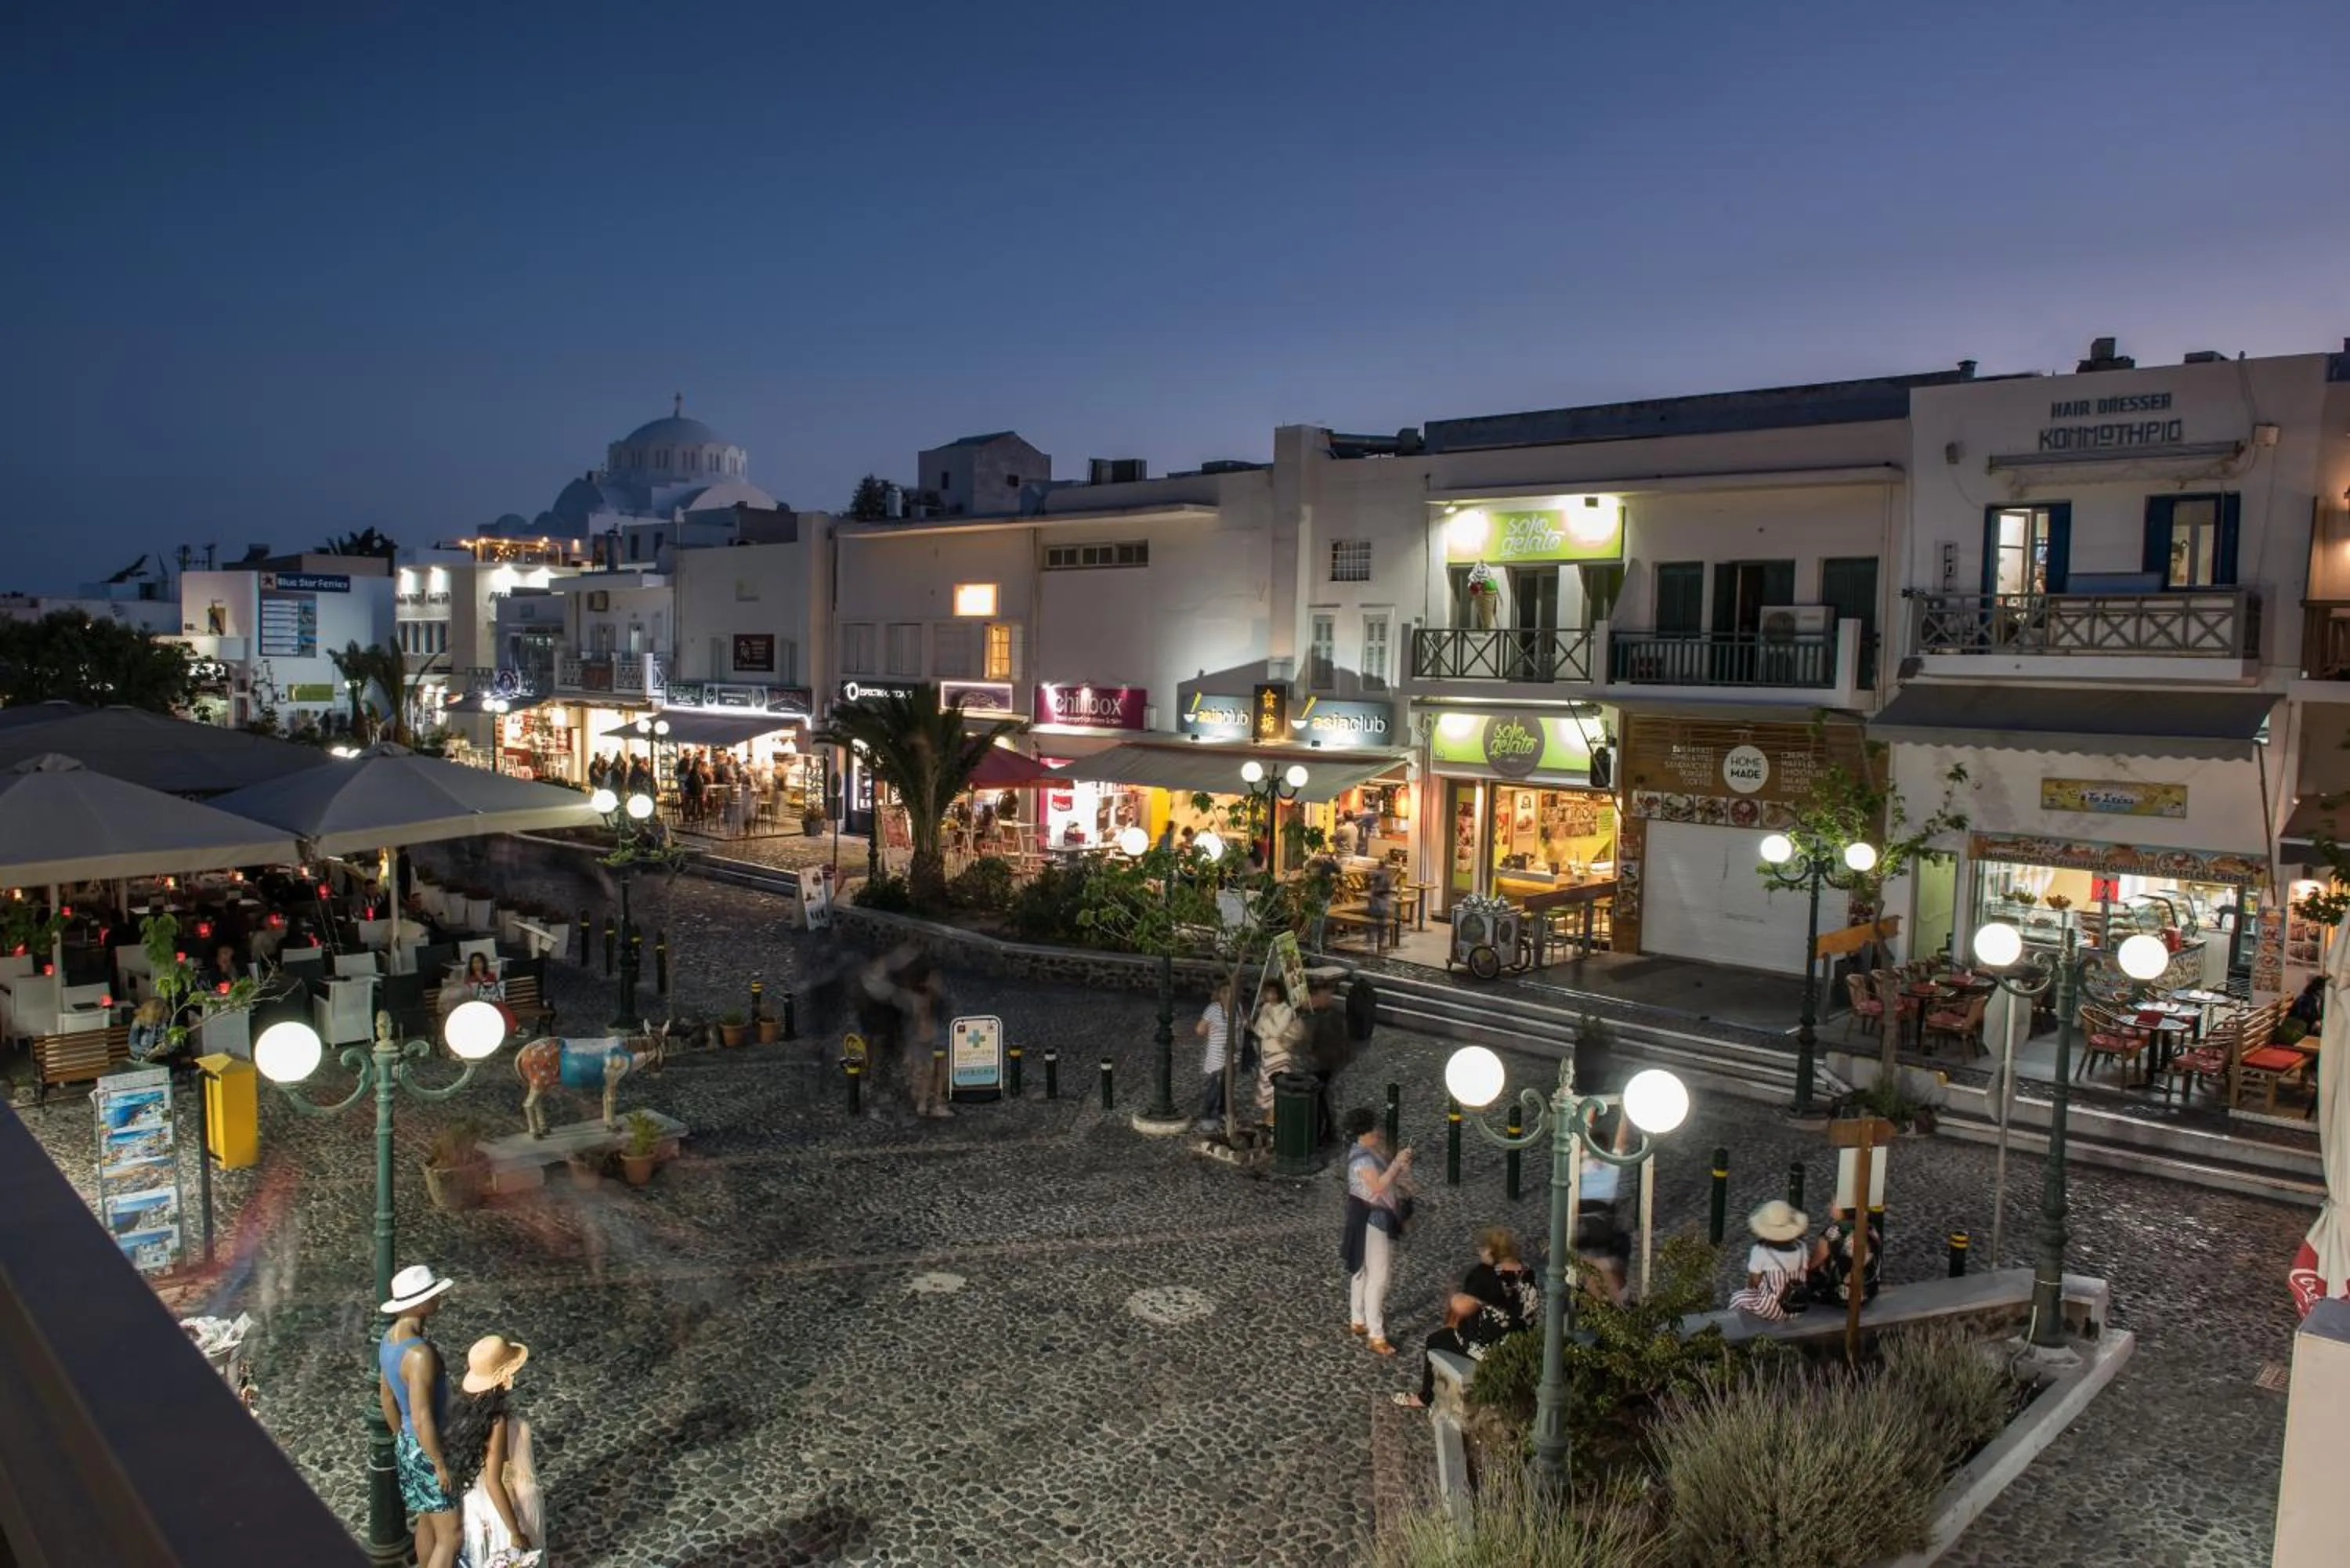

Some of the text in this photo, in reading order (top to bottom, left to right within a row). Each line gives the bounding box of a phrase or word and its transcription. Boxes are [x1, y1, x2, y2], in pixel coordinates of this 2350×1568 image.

[2051, 392, 2171, 418] HAIR DRESSER
[1507, 515, 1549, 537] solo
[1499, 528, 1565, 556] gelato
[278, 577, 348, 588] Blue Star Ferries
[1494, 716, 1525, 739] solo
[1490, 736, 1538, 757] gelato
[1730, 756, 1761, 767] HOME
[1730, 769, 1761, 779] MADE
